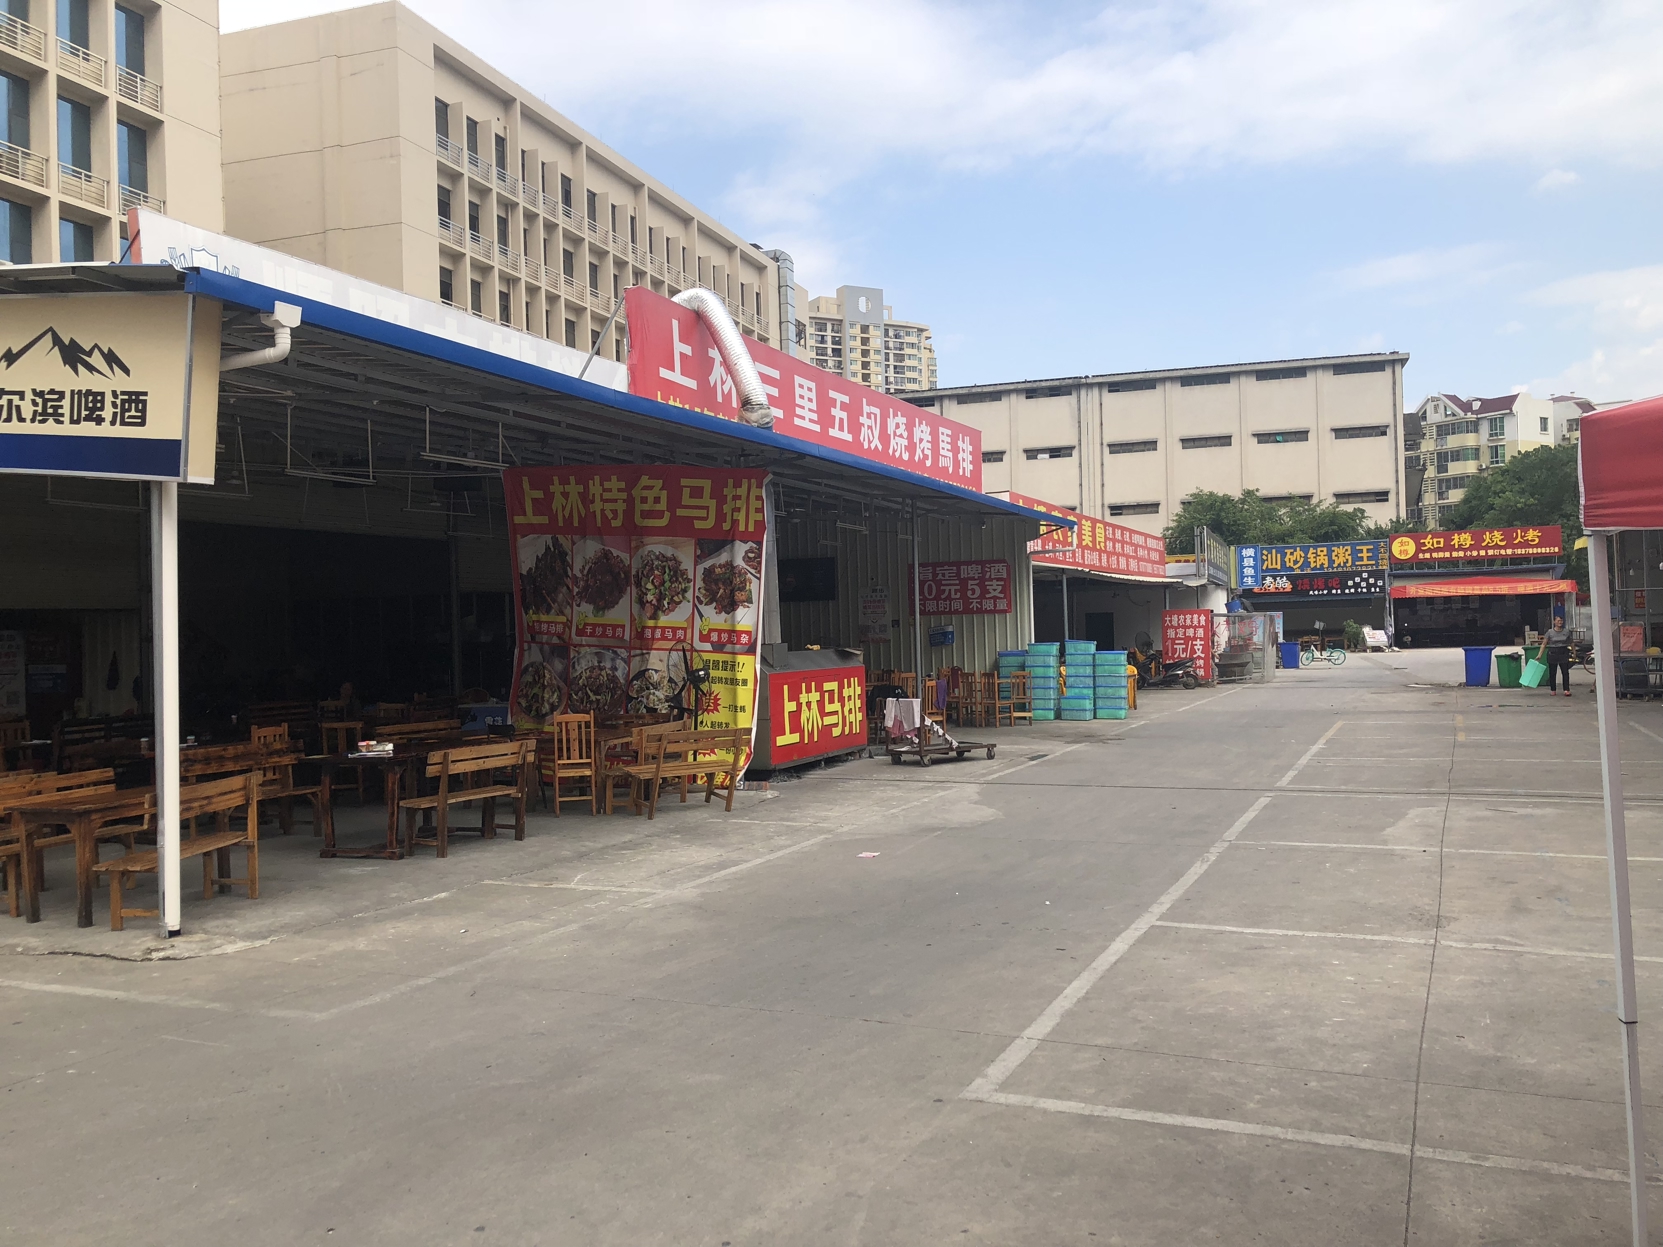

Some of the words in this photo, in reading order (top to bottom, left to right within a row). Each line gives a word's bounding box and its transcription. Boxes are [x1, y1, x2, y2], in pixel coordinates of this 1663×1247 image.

[512, 475, 764, 532] 上林特色马排
[1420, 529, 1542, 550] 如樽烧烤
[1241, 548, 1257, 586] 横县鱼生
[1262, 545, 1376, 571] 汕砂锅粥王
[969, 599, 1008, 611] 不限量
[1166, 627, 1204, 638] 指定啤酒
[1165, 638, 1205, 658] 1元/支
[776, 677, 863, 747] 上林马排
